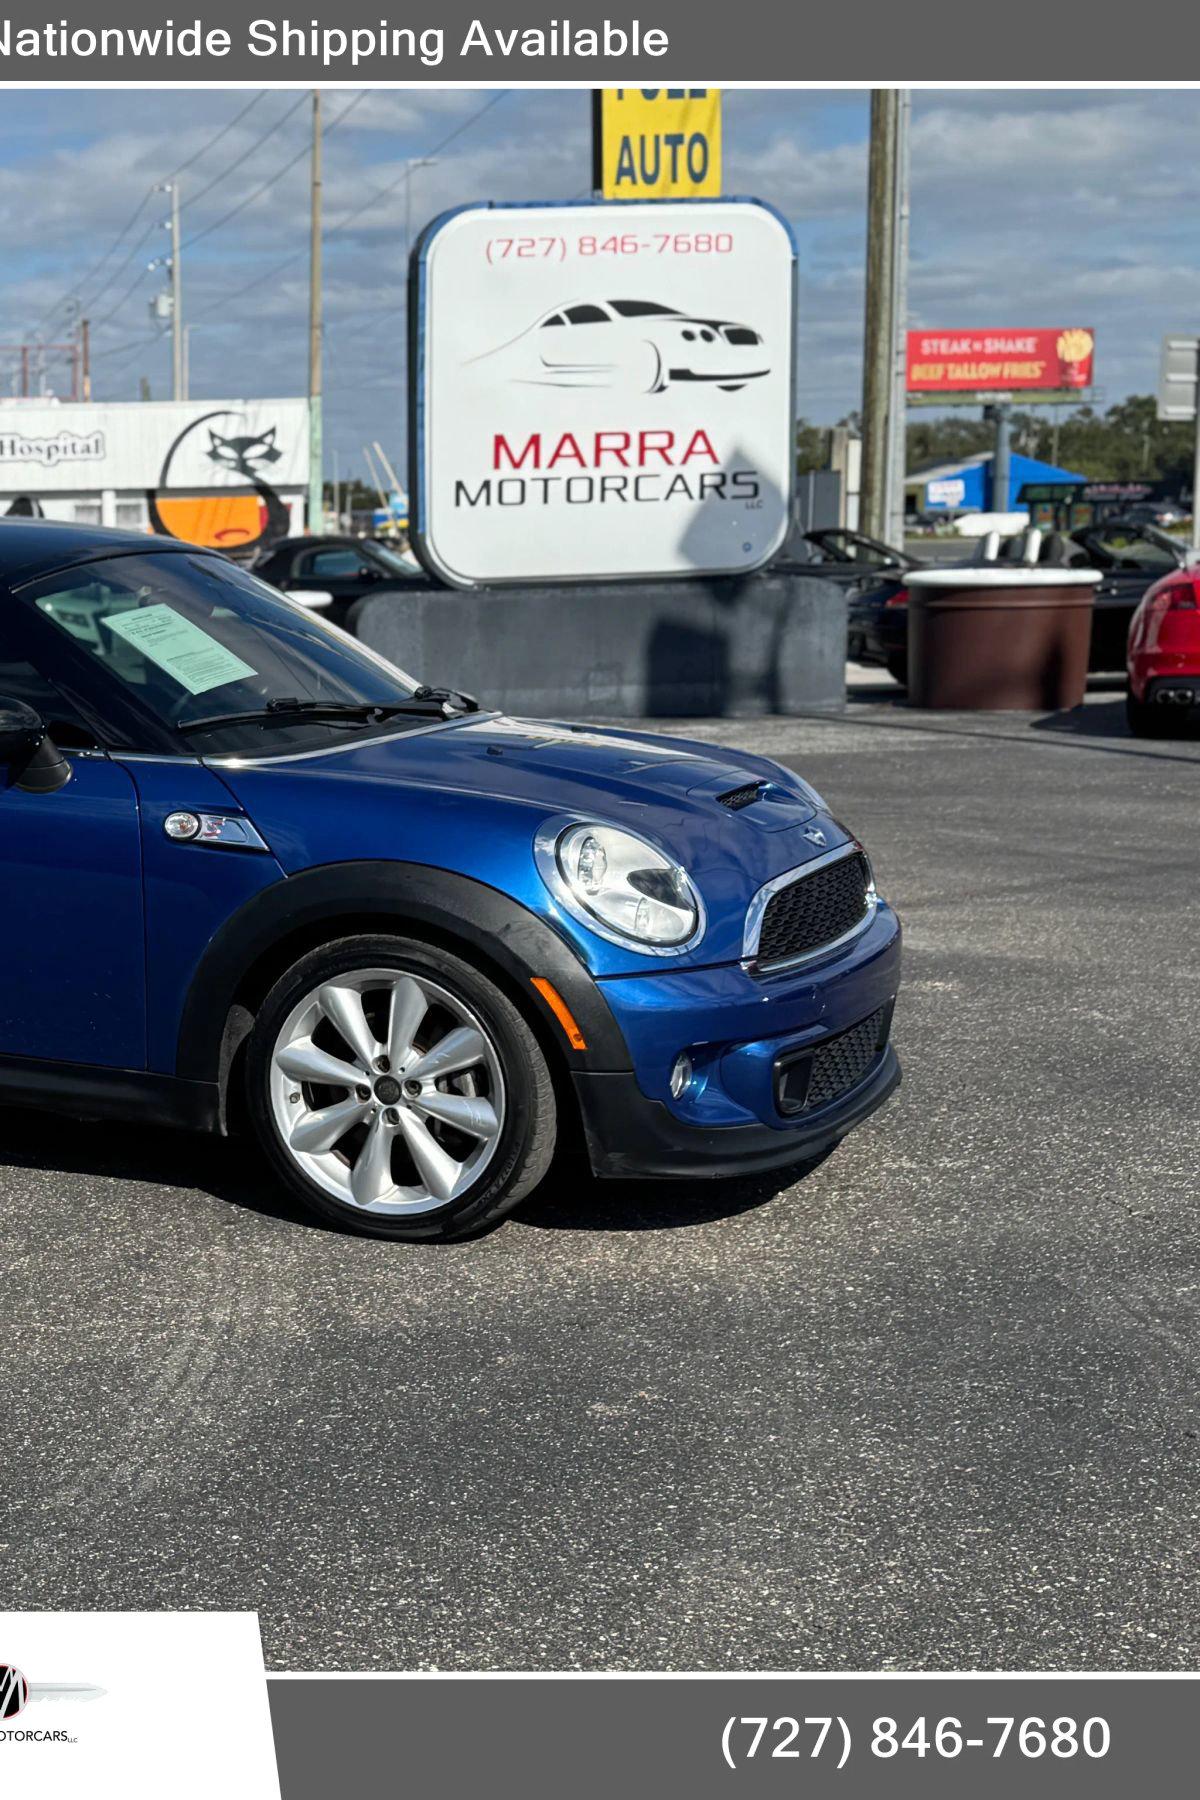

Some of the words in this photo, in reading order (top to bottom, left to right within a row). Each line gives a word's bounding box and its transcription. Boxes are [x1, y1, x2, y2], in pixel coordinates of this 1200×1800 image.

[615, 132, 709, 186] AUTO
[486, 237, 567, 265] (727)
[577, 233, 734, 257] 846-7680
[493, 429, 721, 470] MARRA
[454, 470, 760, 507] MOTORCARS
